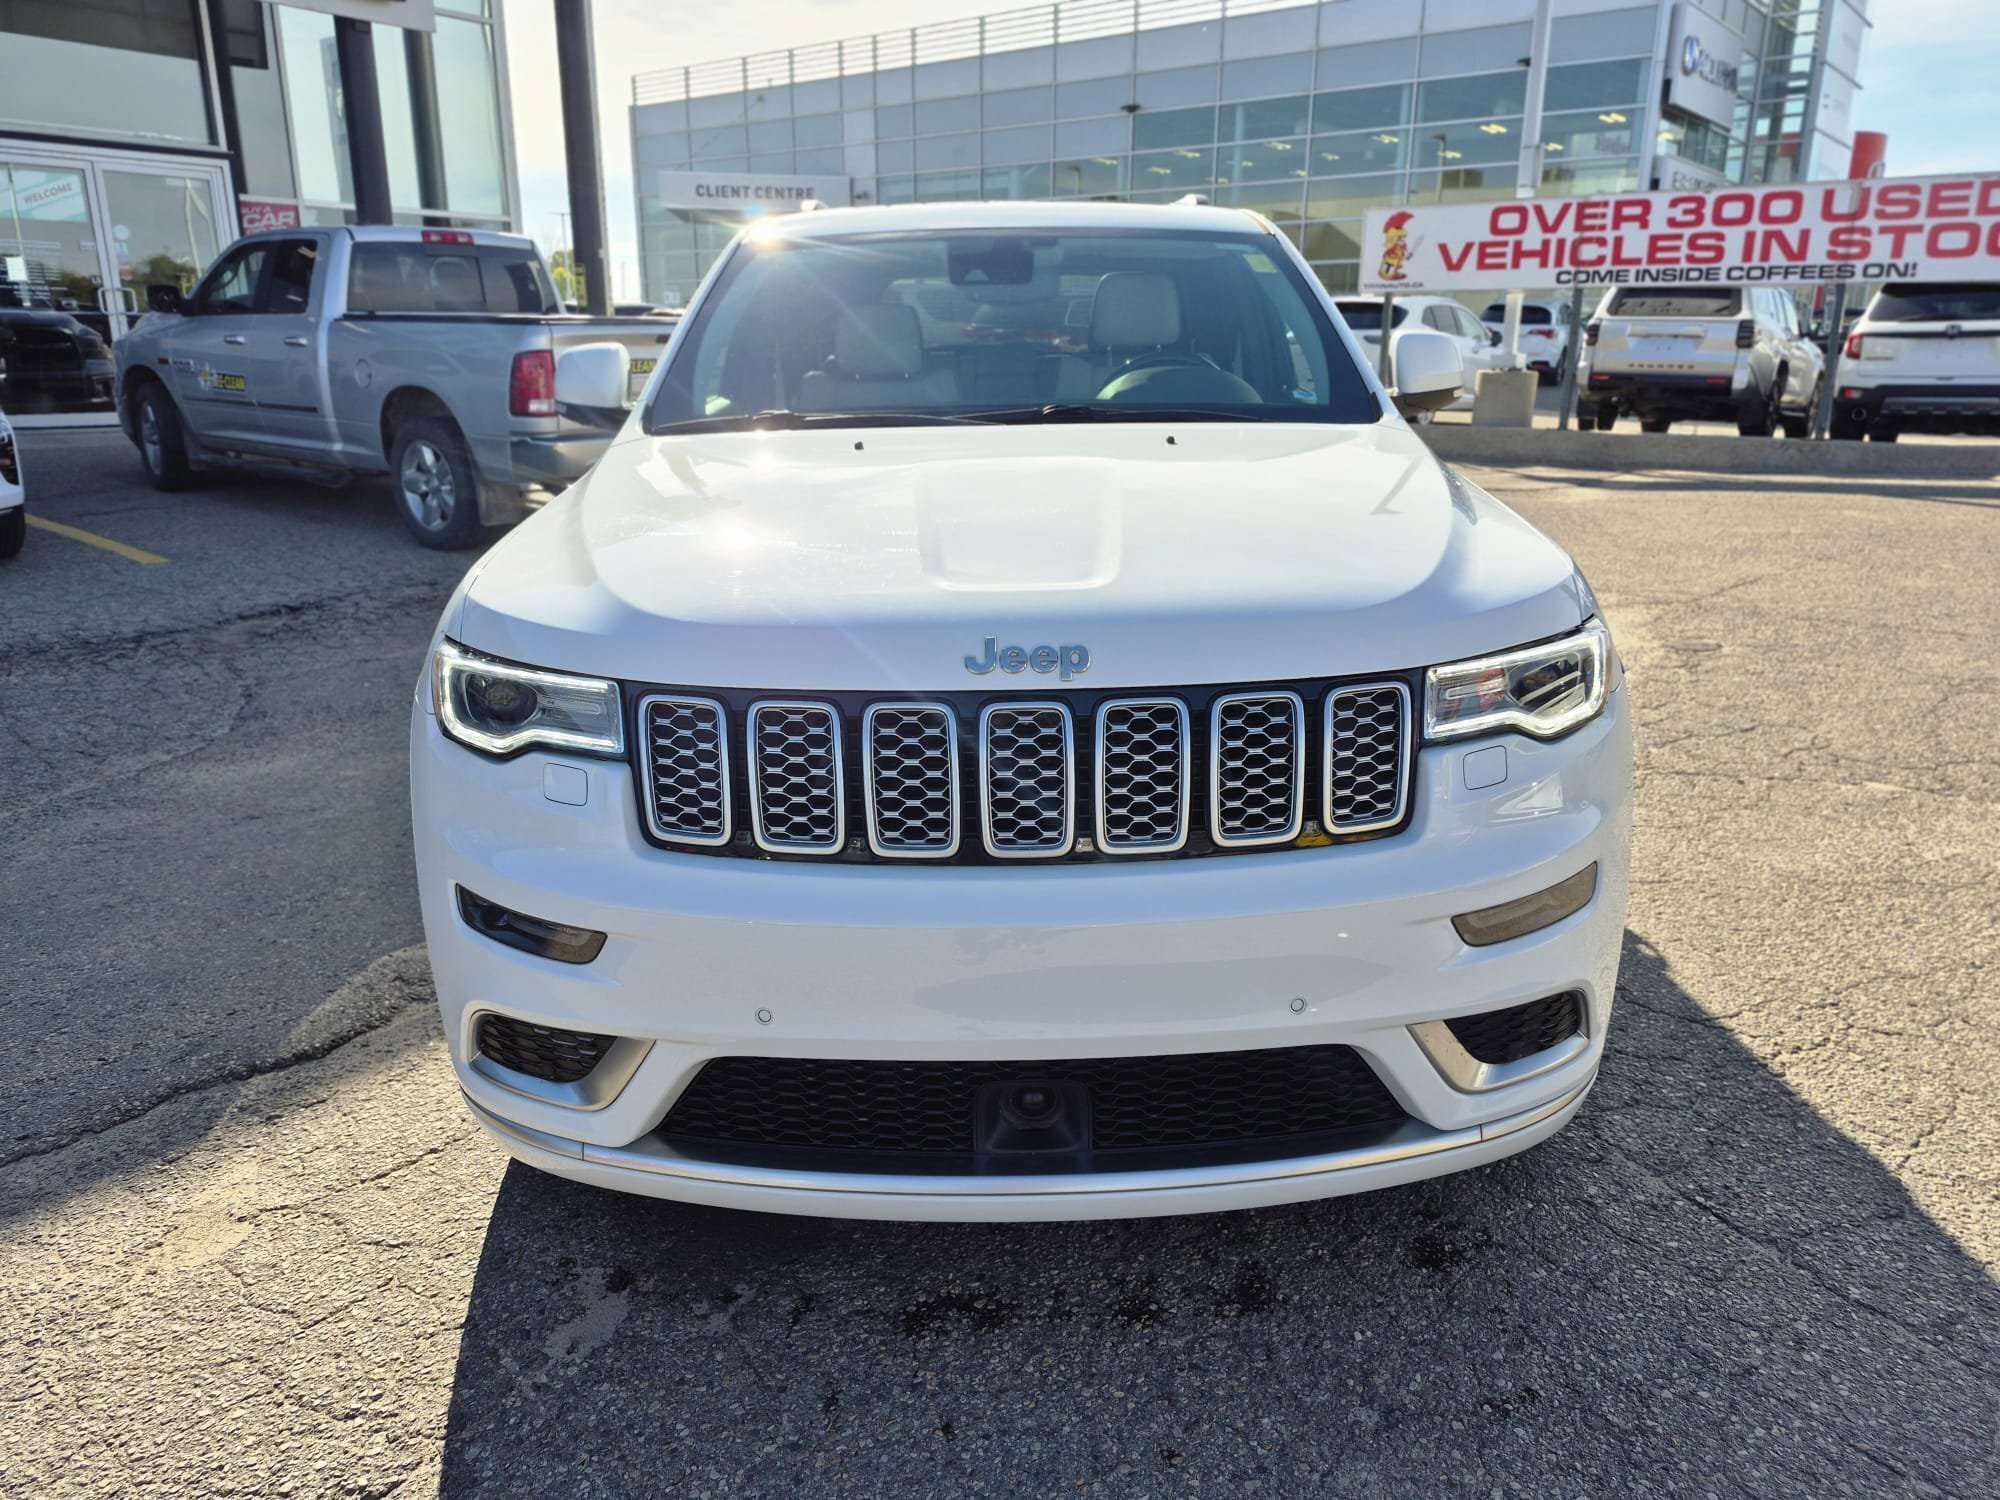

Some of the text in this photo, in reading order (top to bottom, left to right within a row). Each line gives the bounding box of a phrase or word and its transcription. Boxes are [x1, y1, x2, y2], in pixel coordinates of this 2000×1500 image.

[24, 182, 73, 203] WELCOME
[695, 184, 816, 200] CLIENT CENTRE
[243, 211, 295, 228] CAR
[1489, 198, 1653, 237] OVER
[1666, 190, 1804, 229] 300
[1438, 221, 2000, 272] VEHICLES IN STO
[1555, 262, 1918, 285] COME INSIDE COFFEES ON!
[964, 636, 1090, 682] Jeep
